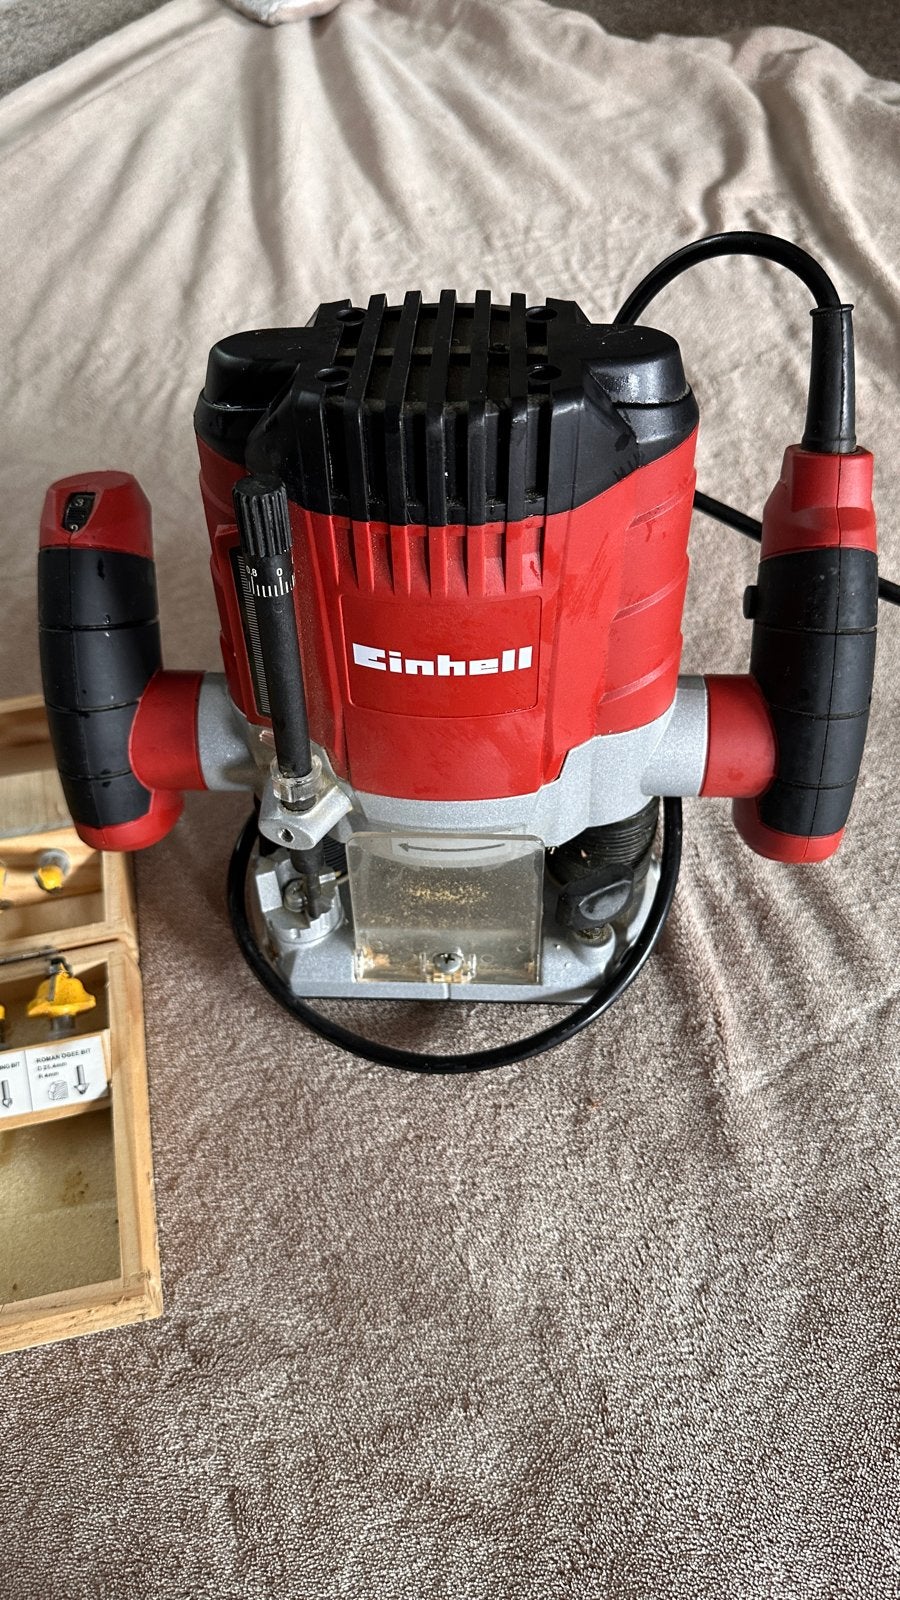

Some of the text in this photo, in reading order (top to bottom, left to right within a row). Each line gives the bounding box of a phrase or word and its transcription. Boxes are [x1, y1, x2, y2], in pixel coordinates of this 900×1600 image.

[276, 567, 283, 577] 0
[352, 642, 533, 677] Einhell
[36, 1055, 60, 1063] ROMAN
[61, 1051, 79, 1059] OGEE
